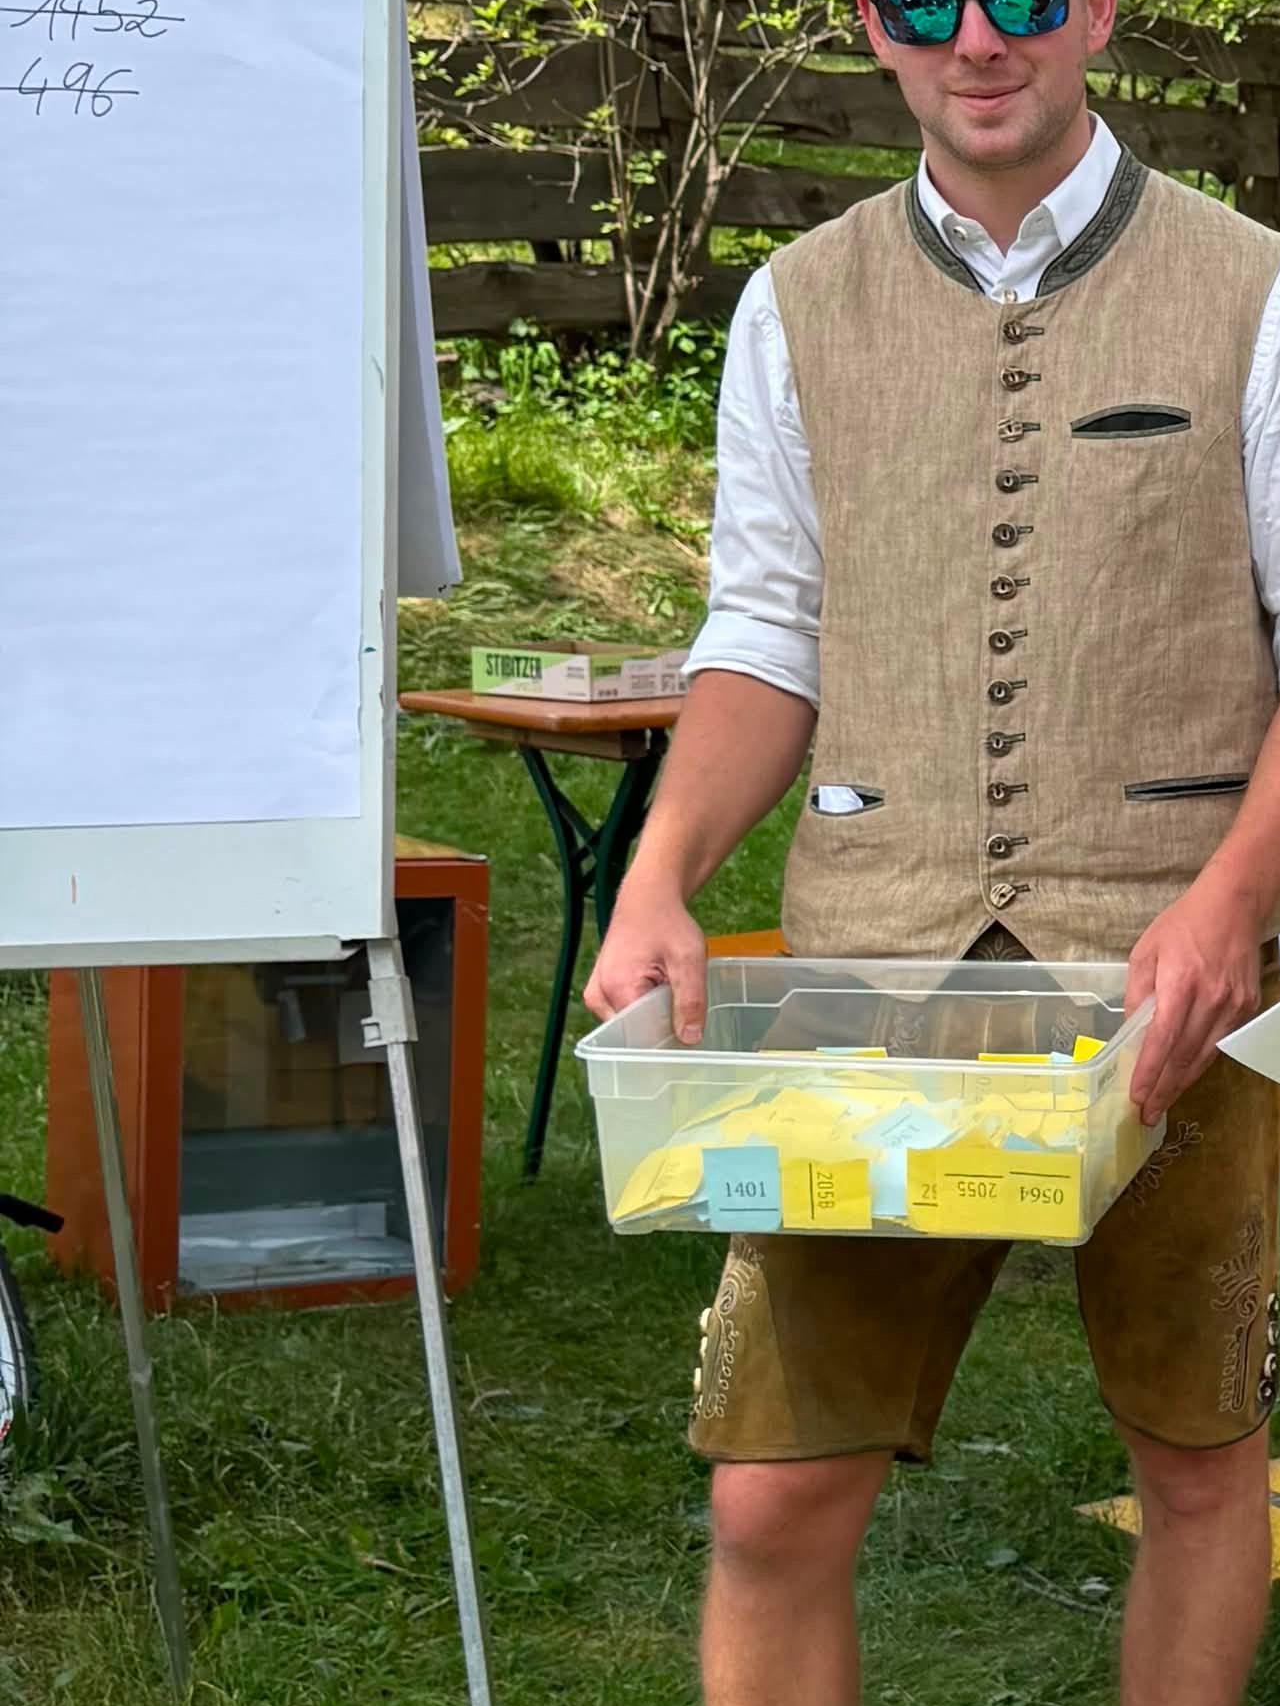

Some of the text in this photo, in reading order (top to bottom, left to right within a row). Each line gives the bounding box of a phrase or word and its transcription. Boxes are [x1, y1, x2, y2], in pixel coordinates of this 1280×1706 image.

[17, 56, 134, 118] 496
[725, 1180, 767, 1198] 1401
[957, 1180, 998, 1198] 2055
[1018, 1185, 1065, 1206] 0564
